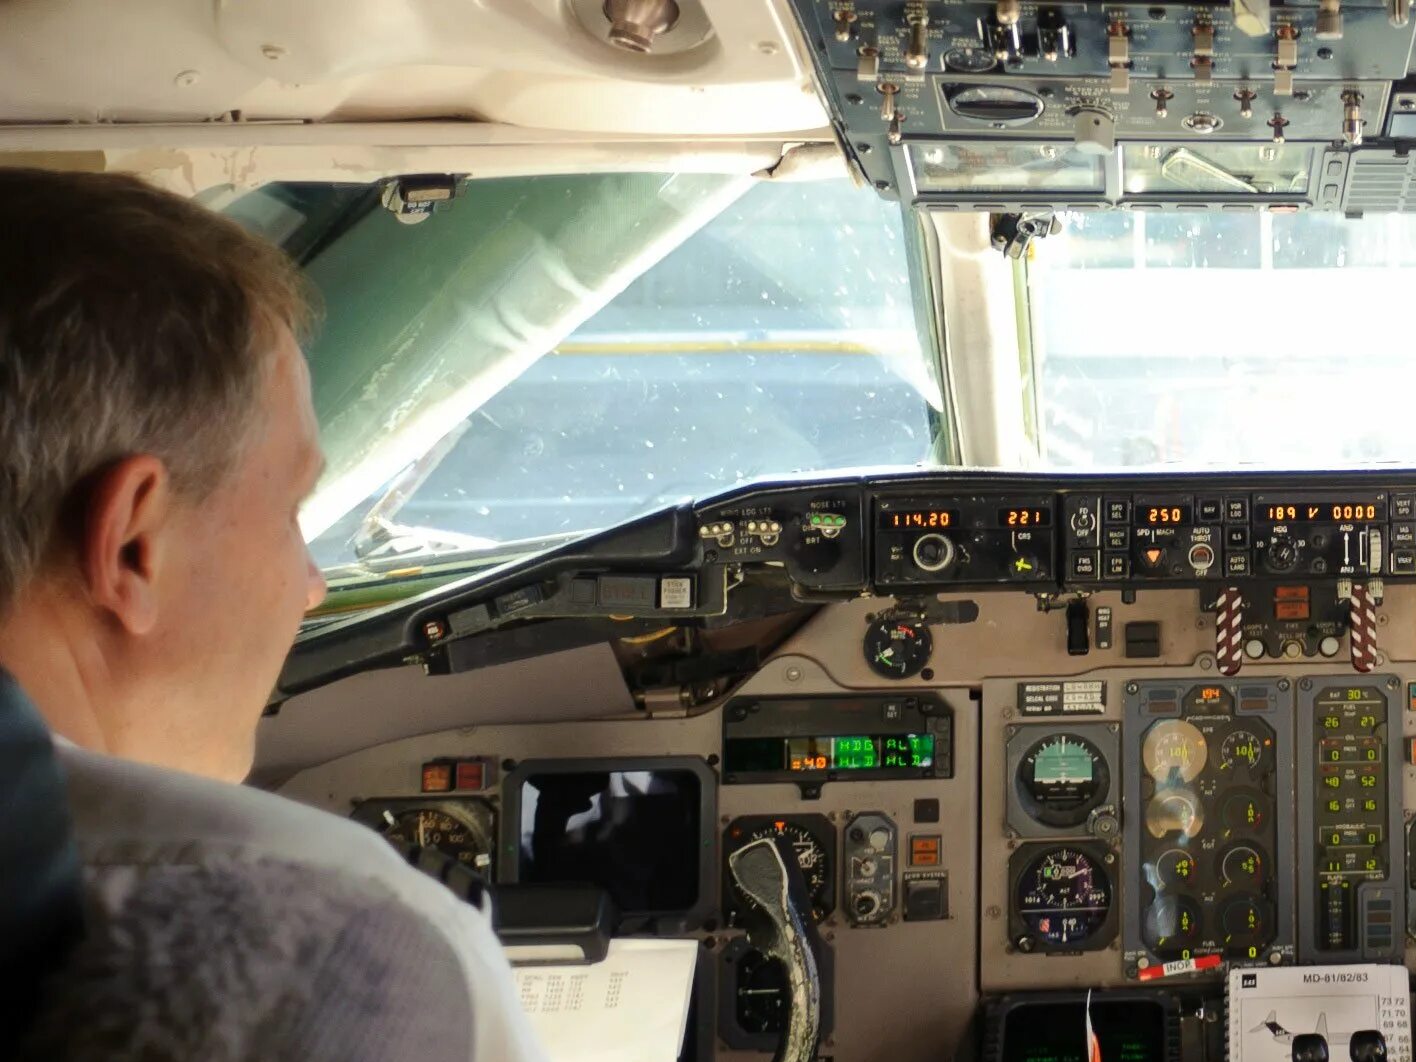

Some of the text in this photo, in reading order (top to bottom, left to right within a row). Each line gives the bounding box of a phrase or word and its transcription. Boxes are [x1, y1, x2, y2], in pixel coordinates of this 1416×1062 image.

[1007, 510, 1042, 525] 221
[1149, 507, 1181, 523] 250
[1268, 506, 1296, 520] 189
[1333, 505, 1376, 520] 0000
[1076, 529, 1089, 538] OFF
[1137, 529, 1150, 537] SPD
[1193, 527, 1210, 535] AUTO
[1273, 526, 1288, 534] HDG
[1195, 569, 1208, 577] OFF
[838, 740, 874, 751] HDG
[1331, 750, 1340, 761] 0
[1367, 749, 1376, 760] 0
[1361, 776, 1376, 787] 52
[1332, 834, 1340, 845] 0
[1368, 833, 1376, 844] 0
[1182, 949, 1190, 961] 0
[1248, 947, 1257, 959] 0
[1166, 959, 1191, 973] INOP
[1303, 973, 1369, 984] MD-81/82/83
